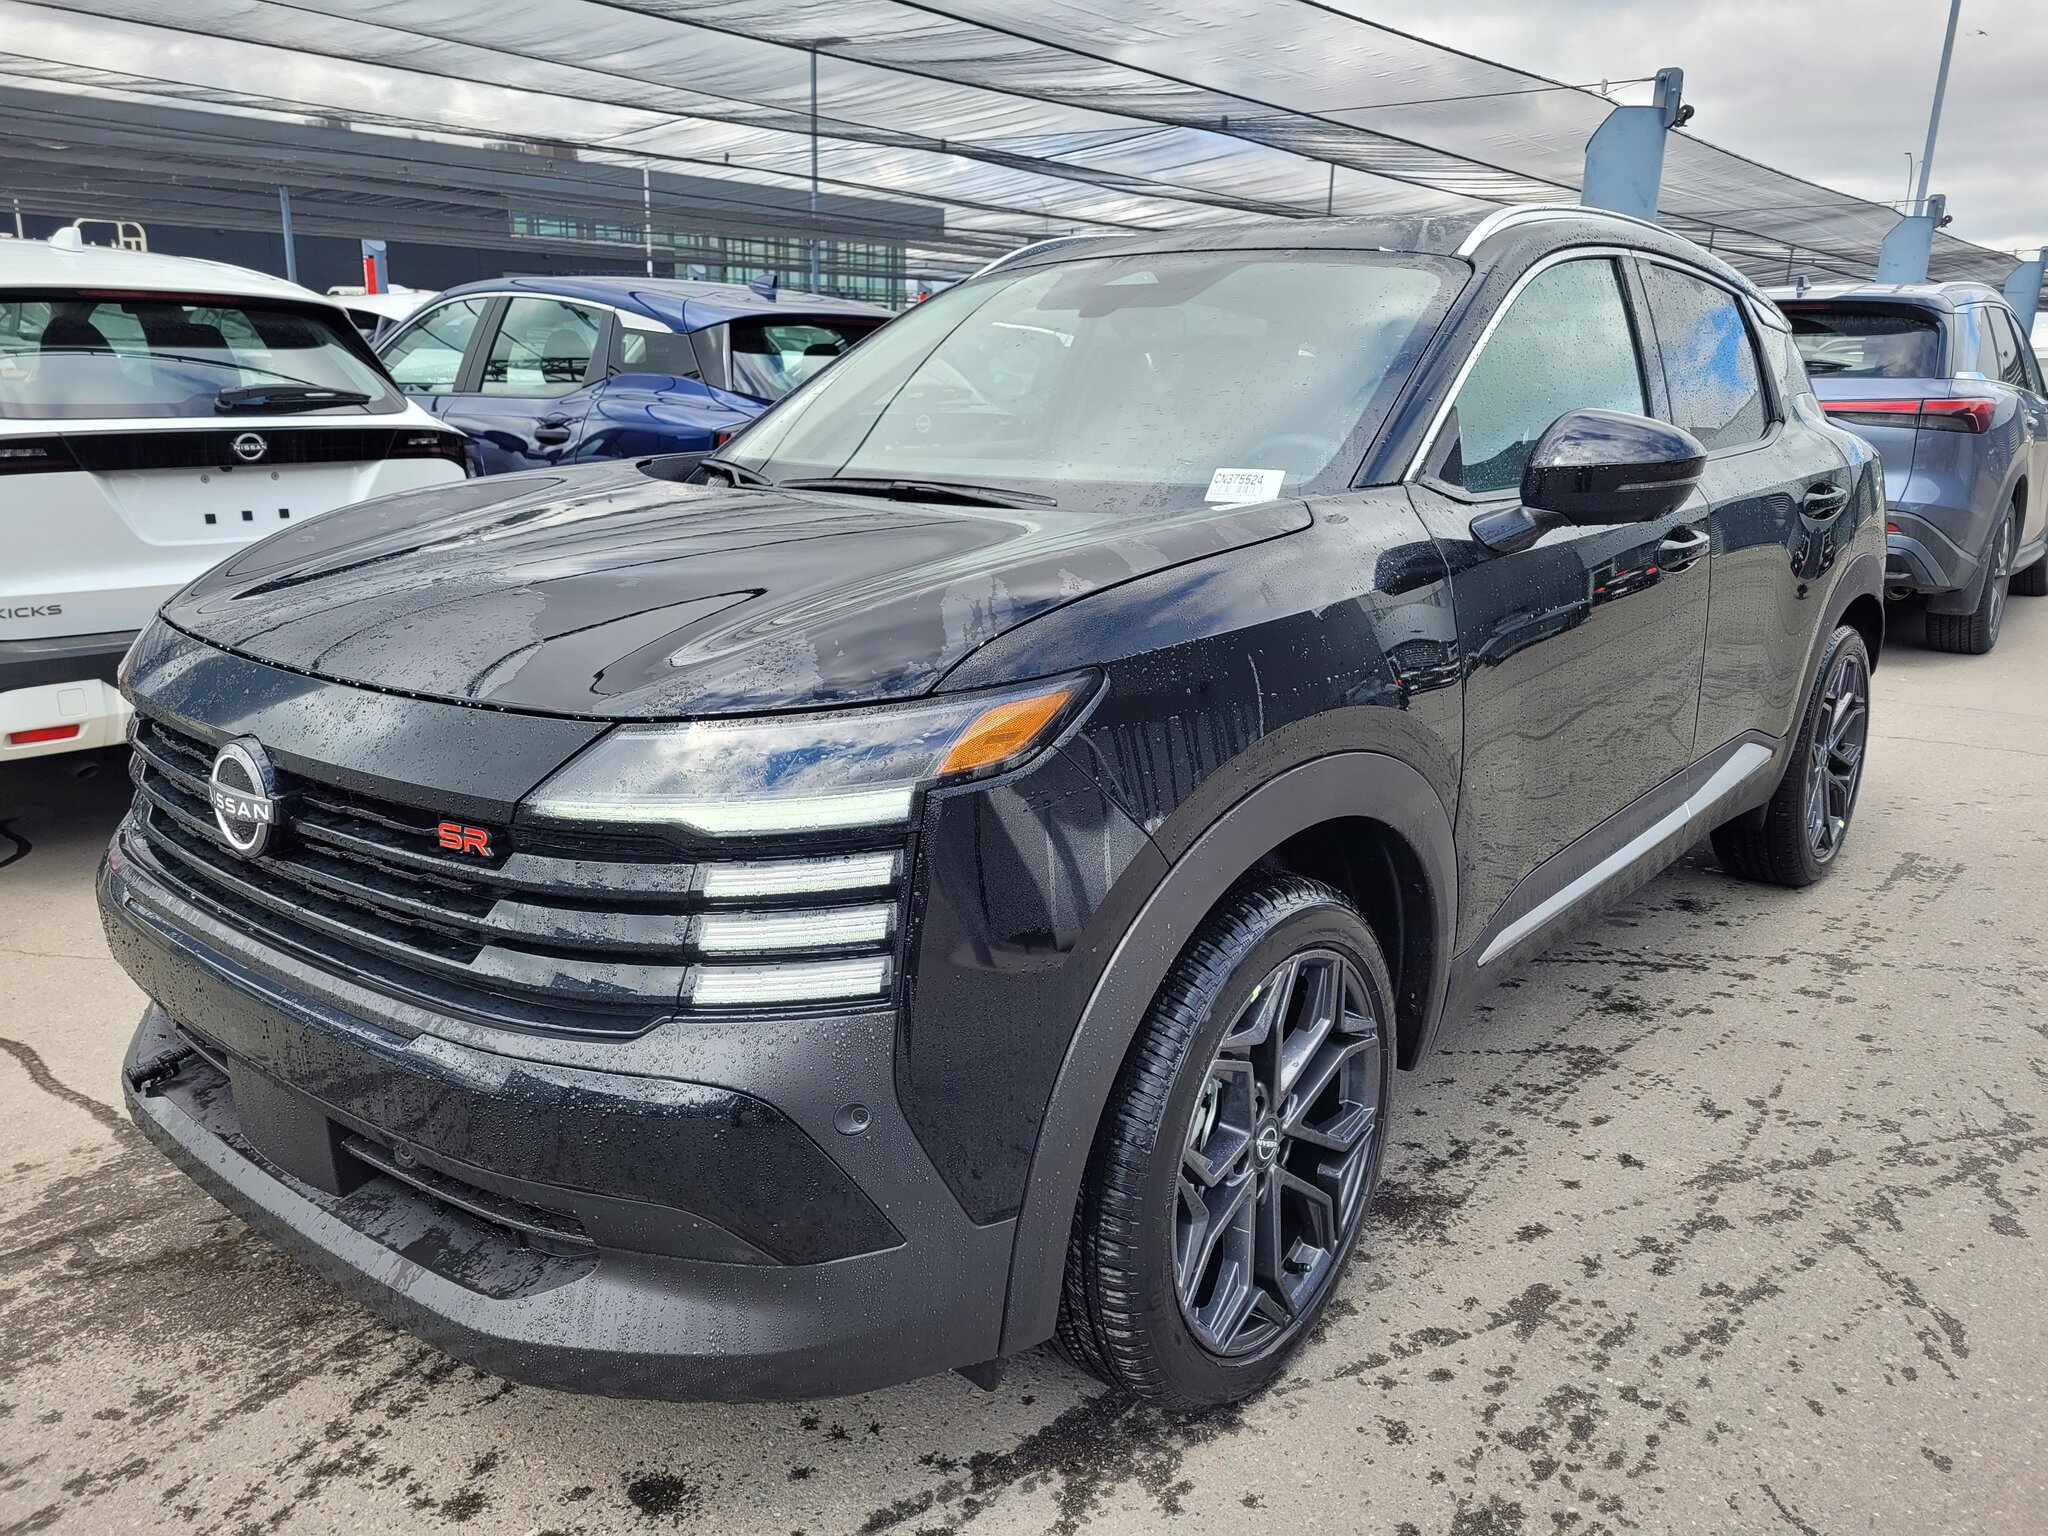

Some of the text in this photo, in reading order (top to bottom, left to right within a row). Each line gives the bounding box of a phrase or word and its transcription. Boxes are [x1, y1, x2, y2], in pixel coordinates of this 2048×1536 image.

[233, 443, 268, 451] NISSAN
[1214, 473, 1265, 485] CN375524
[208, 786, 270, 821] ISSAN
[438, 822, 491, 857] SR
